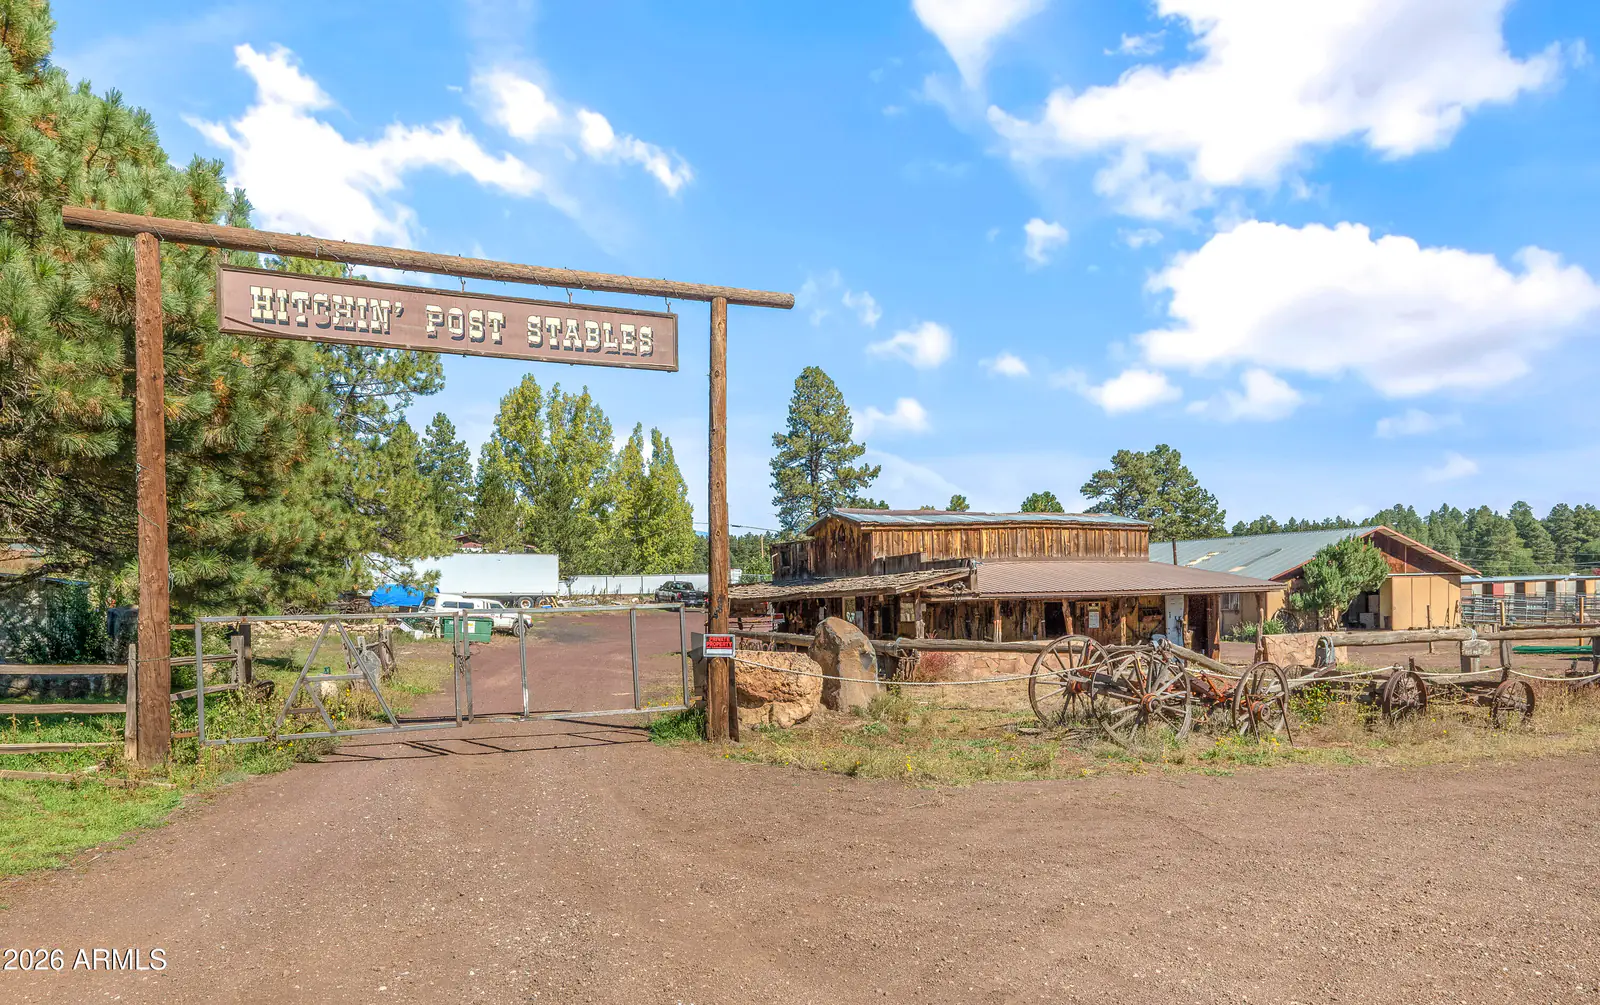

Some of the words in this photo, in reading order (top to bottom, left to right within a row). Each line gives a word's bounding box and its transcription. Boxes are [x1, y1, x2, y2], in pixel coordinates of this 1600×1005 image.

[249, 285, 404, 334] HITCHIN'
[425, 304, 505, 345] POST
[527, 315, 653, 357] STABLES
